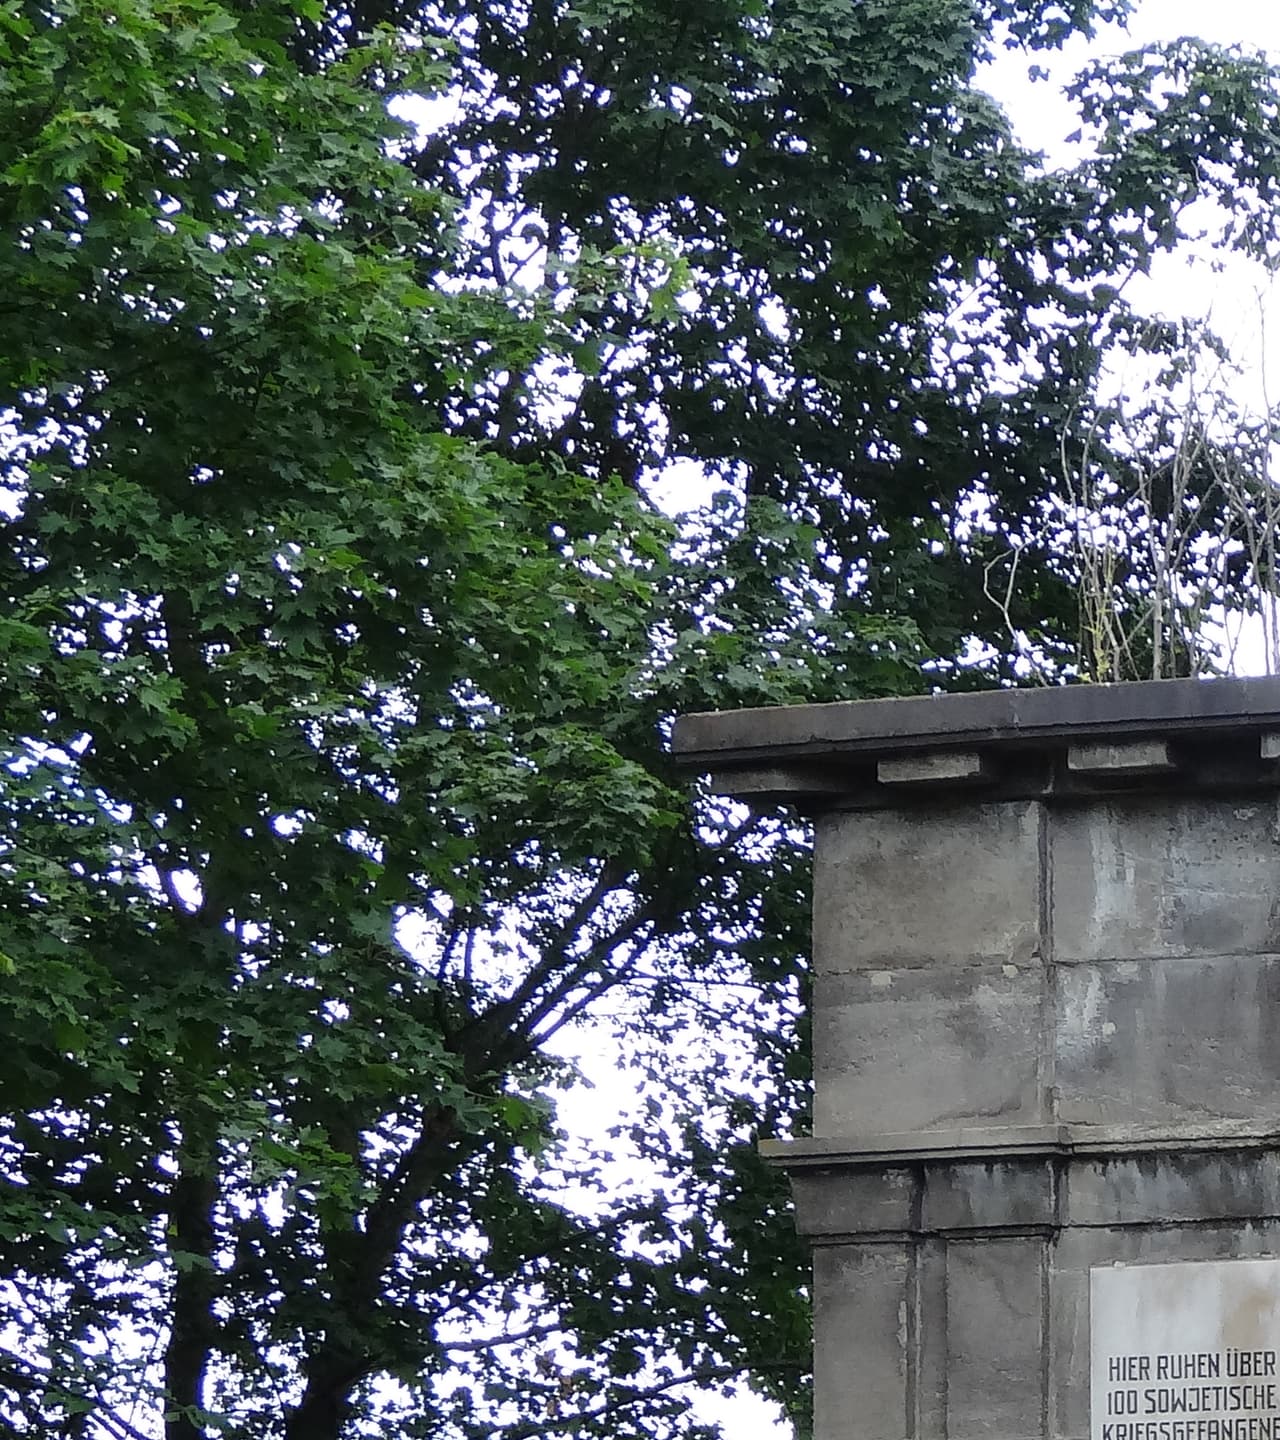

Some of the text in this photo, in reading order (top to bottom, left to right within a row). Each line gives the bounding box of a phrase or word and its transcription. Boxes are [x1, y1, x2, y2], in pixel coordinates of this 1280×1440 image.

[1108, 1348, 1277, 1382] HIER RUHEN ÜBER
[1107, 1384, 1277, 1416] 100 SOWJETISCHE
